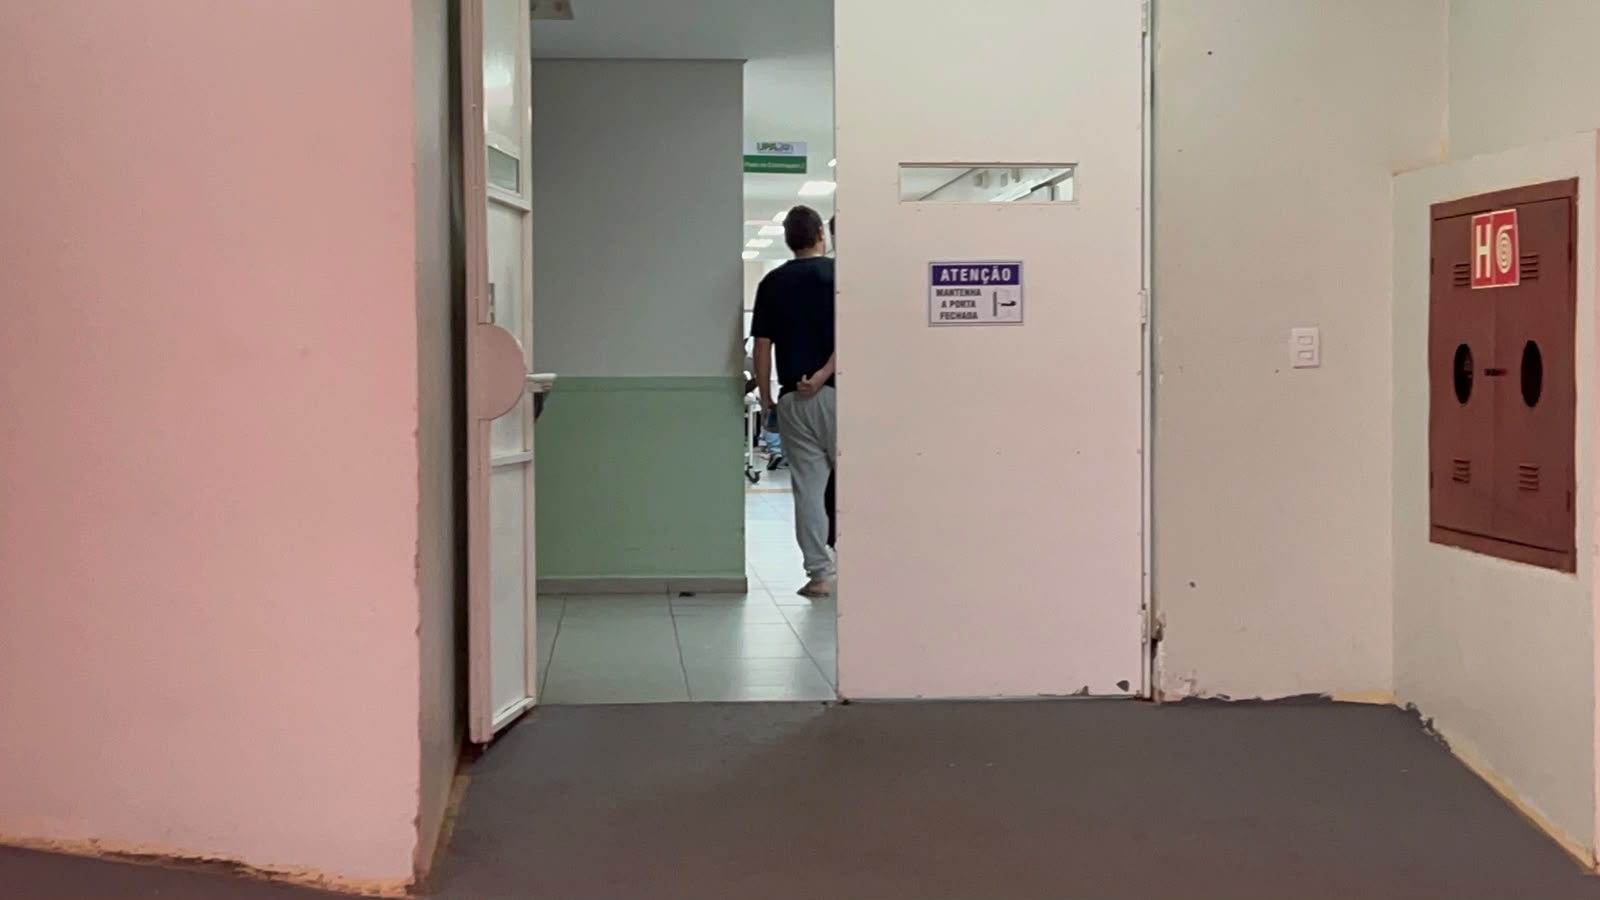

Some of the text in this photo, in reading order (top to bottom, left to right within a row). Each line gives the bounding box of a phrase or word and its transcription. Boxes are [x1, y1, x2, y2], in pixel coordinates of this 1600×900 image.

[1476, 223, 1491, 279] H
[940, 265, 1011, 285] ATENÇÃO
[936, 288, 982, 297] MANTENHA
[941, 300, 976, 308] A PORTA
[940, 311, 978, 320] FECHADA
